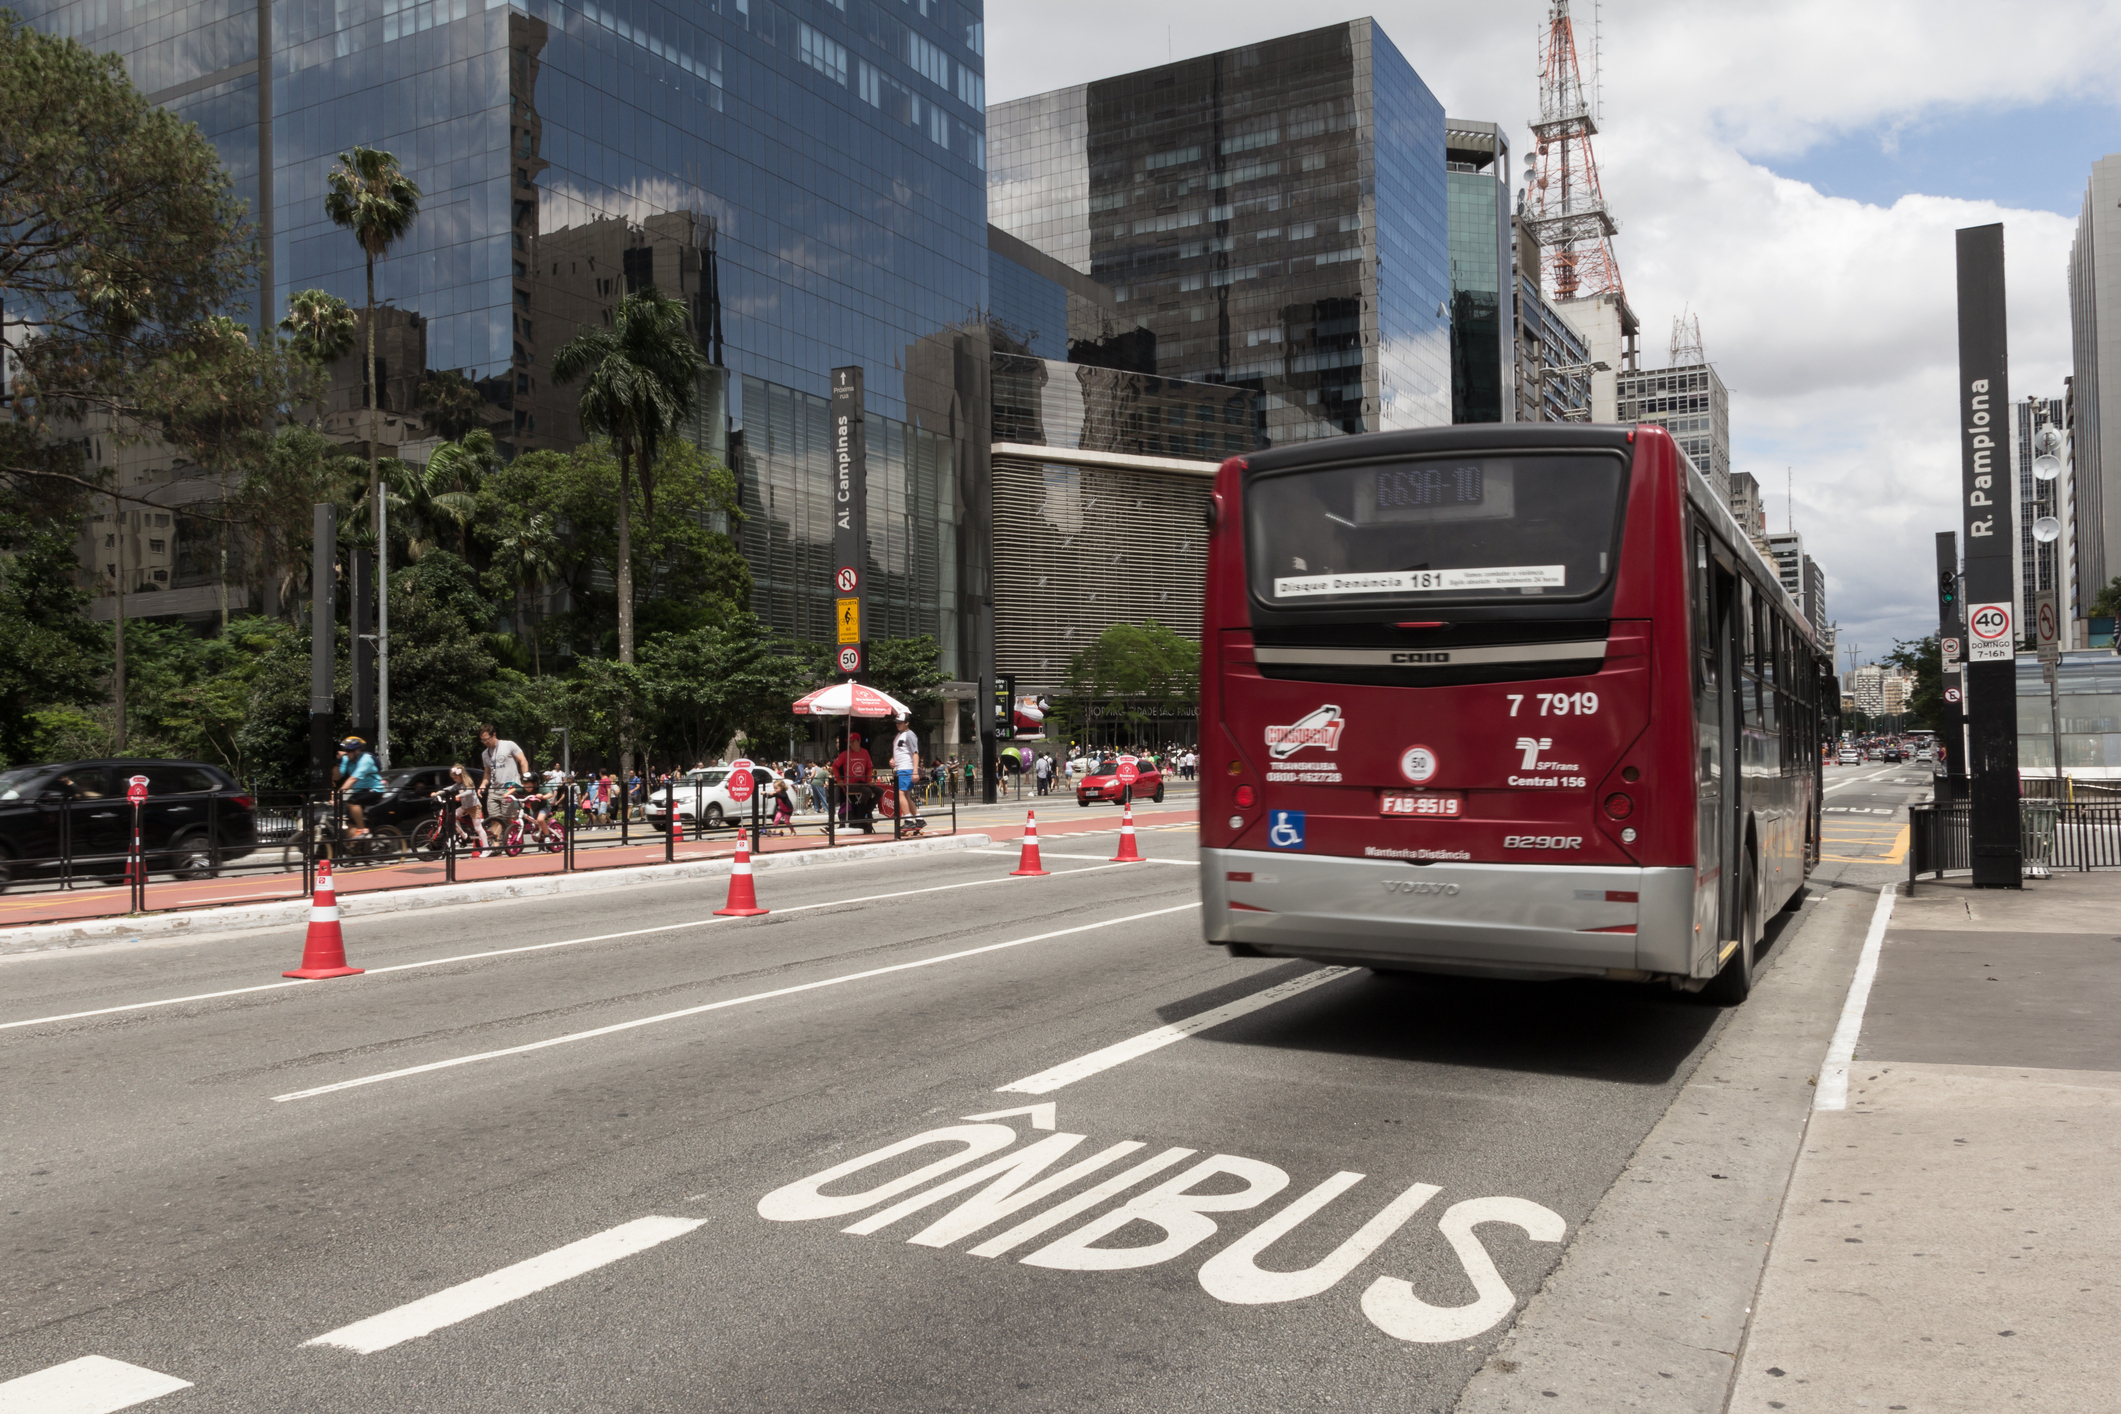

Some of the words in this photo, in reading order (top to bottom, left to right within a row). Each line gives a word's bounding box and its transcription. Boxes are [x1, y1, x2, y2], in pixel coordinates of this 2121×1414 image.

[833, 386, 855, 394] Próxima
[1968, 378, 1996, 507] Pamplona
[836, 415, 851, 502] Campinas
[837, 507, 850, 530] Al.
[1970, 514, 1994, 538] R.
[1280, 582, 1328, 593] Disque
[1333, 578, 1403, 589] Denúncia
[1410, 572, 1443, 588] 181
[1975, 612, 2004, 627] 40
[1971, 641, 2011, 650] DOMINGO
[842, 652, 857, 665] 50
[1391, 653, 1449, 664] CAIO
[1977, 649, 2006, 658] 7-16h
[1506, 694, 1525, 717] 7
[1536, 692, 1599, 717] 7919
[1410, 756, 1428, 769] 50
[1535, 761, 1580, 771] SPTrans
[1507, 775, 1558, 787] Central
[1560, 776, 1587, 788] 156
[1382, 797, 1459, 814] FAB-9519
[1502, 835, 1583, 850] B290R
[1364, 846, 1417, 859] Mantenha
[1418, 848, 1472, 860] Distância
[1381, 880, 1461, 896] VOLVO
[757, 1102, 1567, 1343] ÔNIBUS
